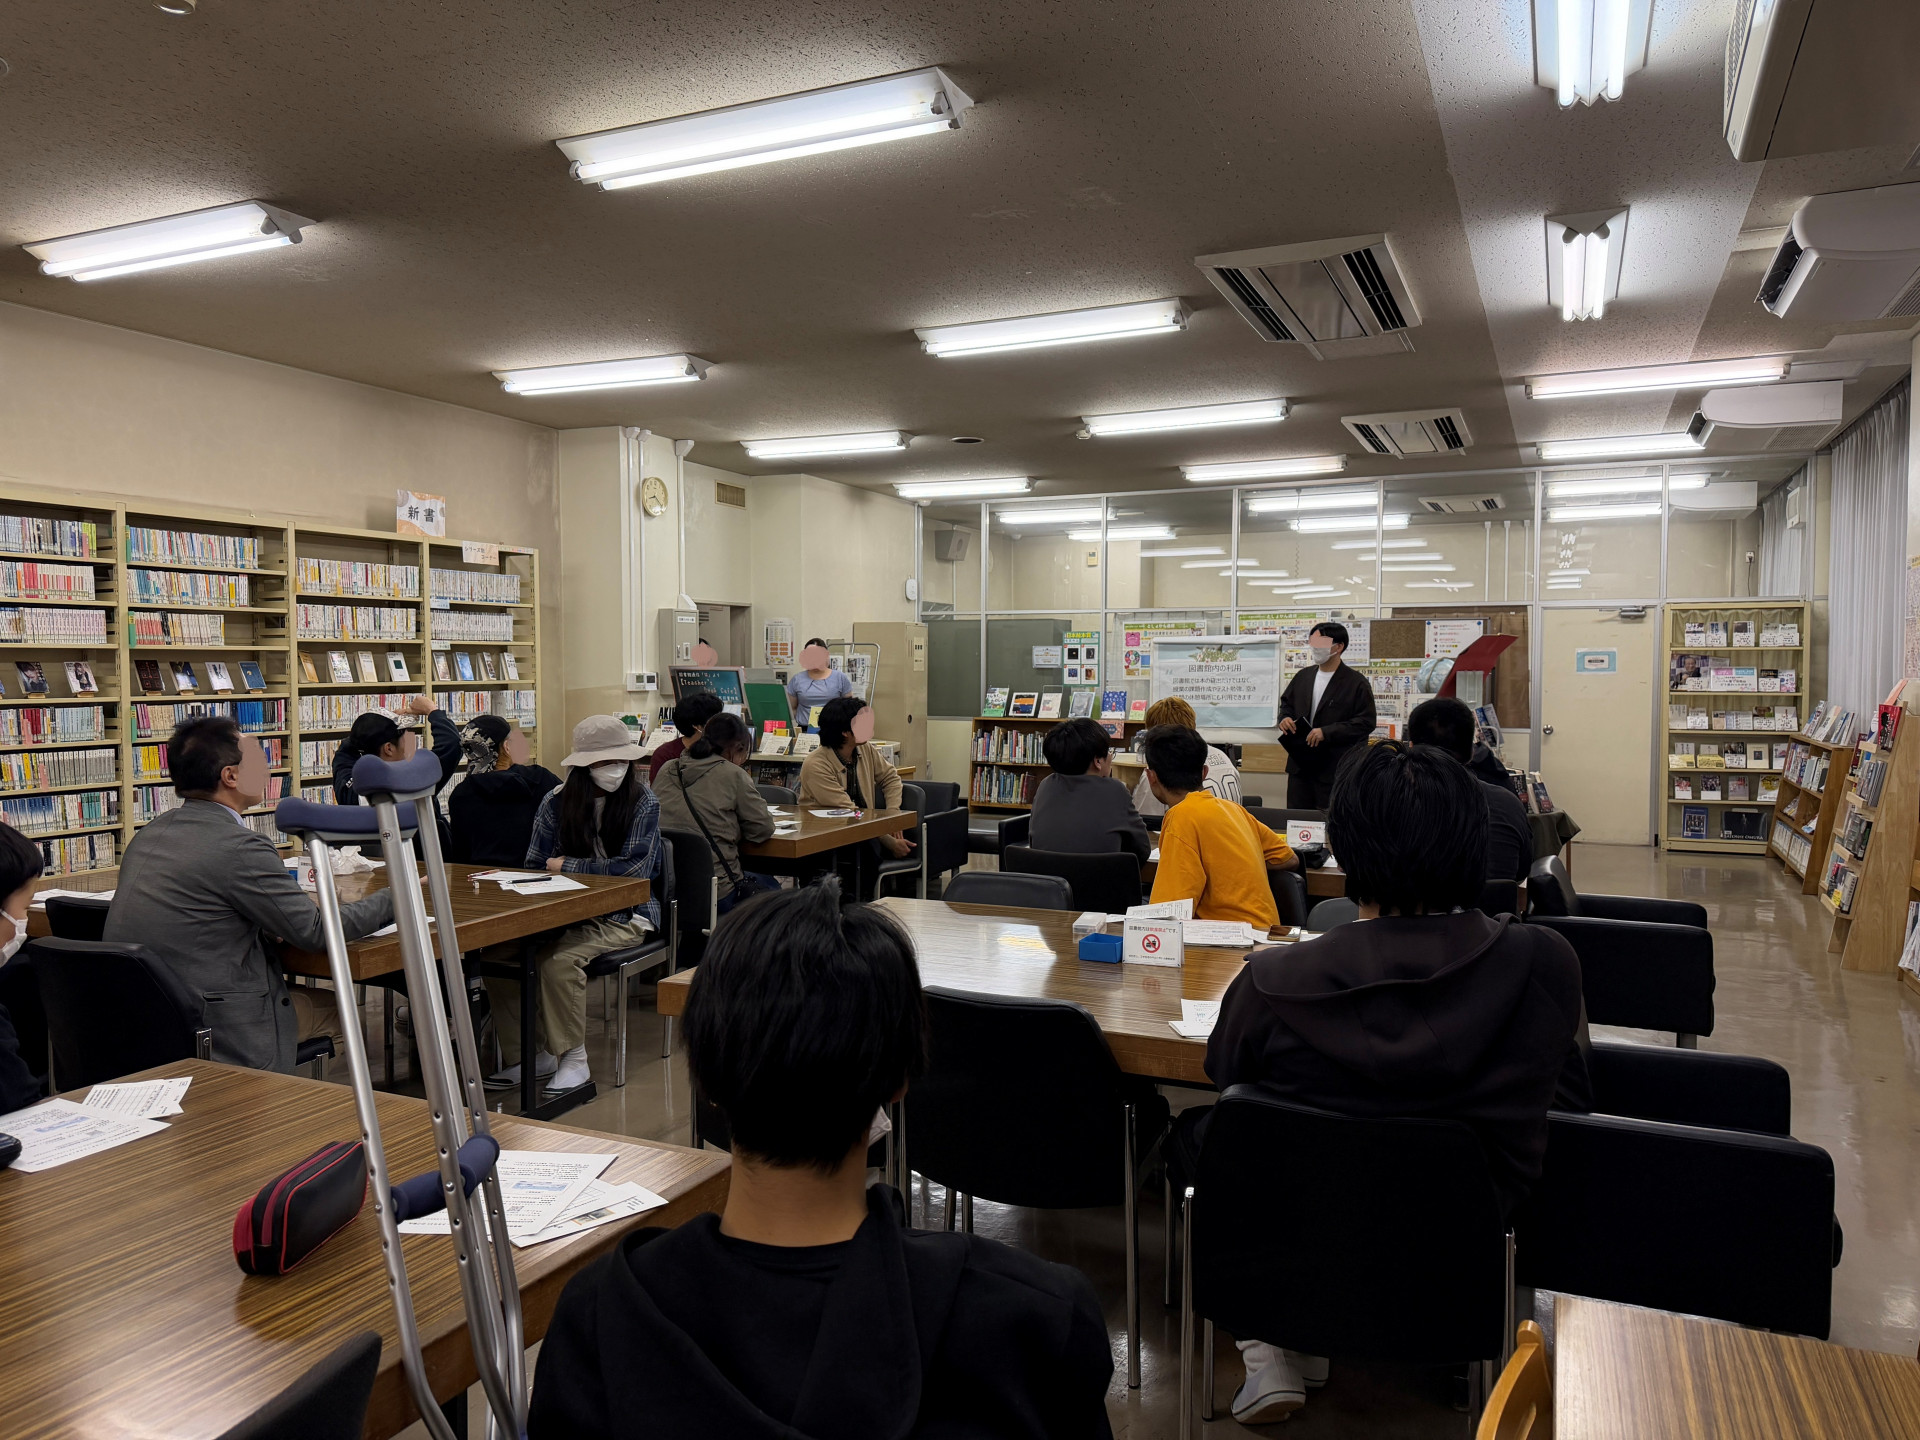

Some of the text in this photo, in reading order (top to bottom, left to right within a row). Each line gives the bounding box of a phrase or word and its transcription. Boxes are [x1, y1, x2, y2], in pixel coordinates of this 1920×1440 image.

[408, 505, 435, 523] 新書
[1188, 664, 1242, 673] 図書館内の利用
[1385, 676, 1391, 684] 2
[1404, 676, 1410, 684] 3
[382, 831, 391, 840] 中
